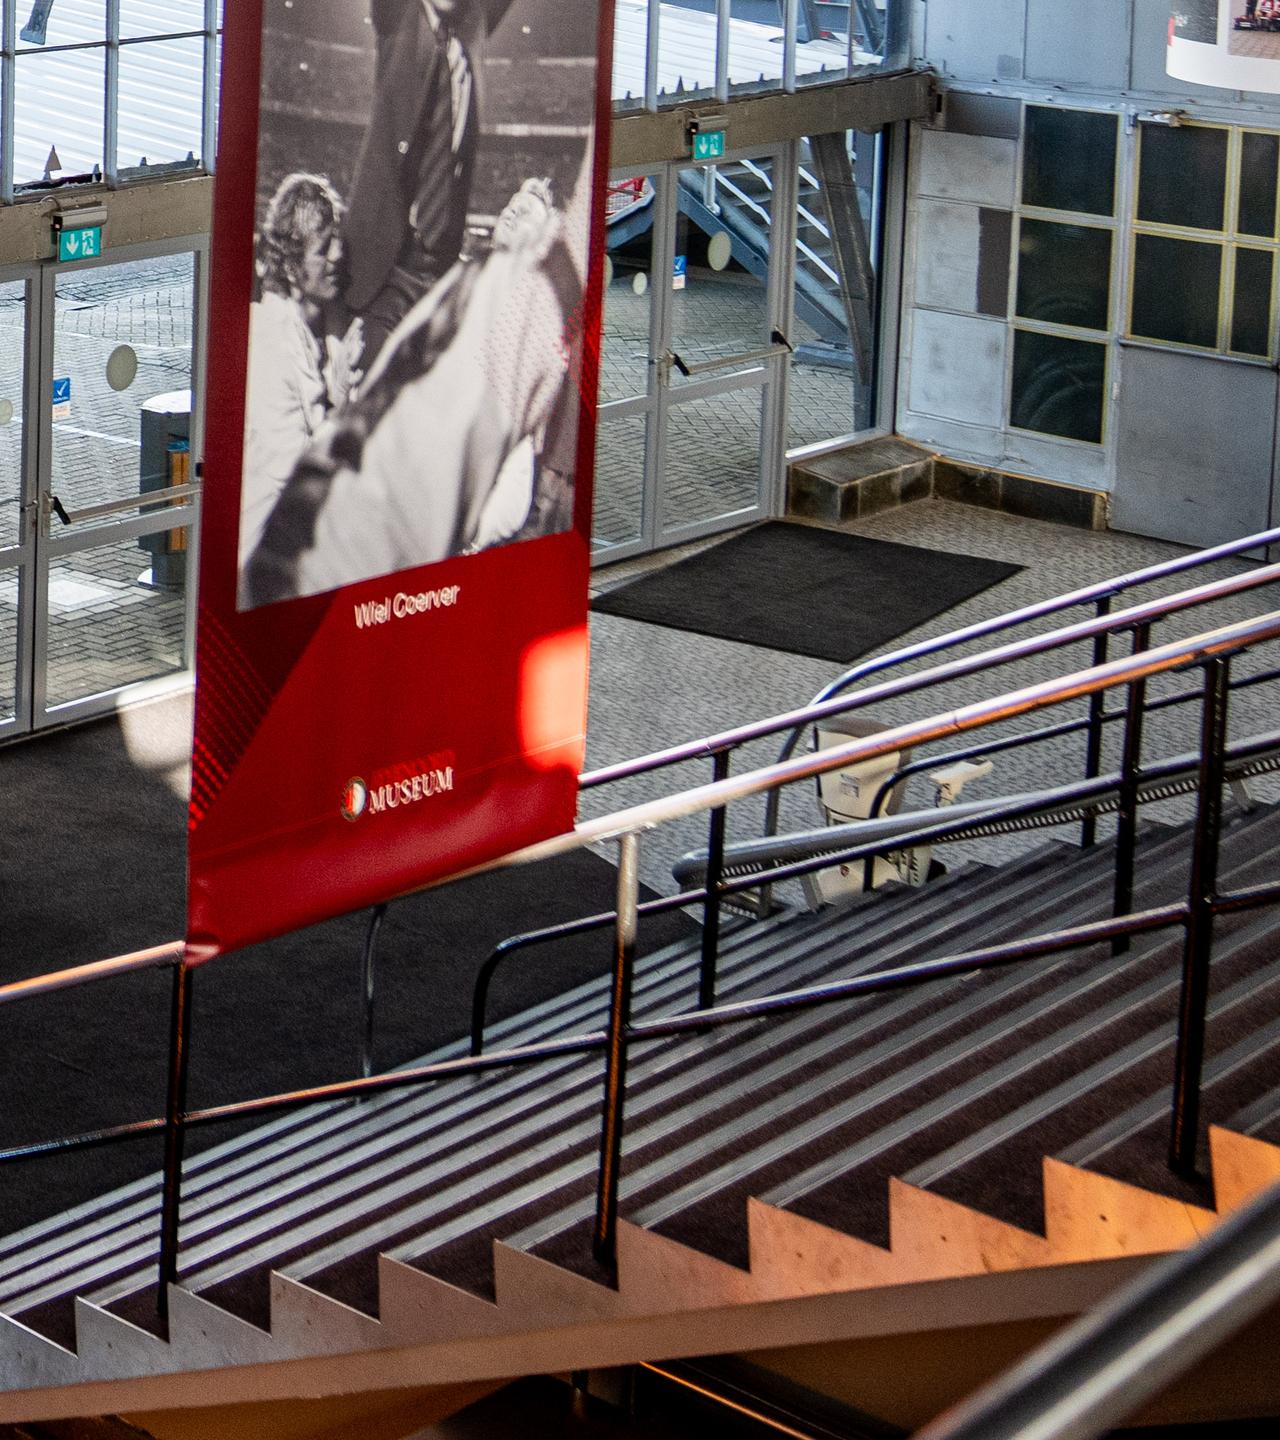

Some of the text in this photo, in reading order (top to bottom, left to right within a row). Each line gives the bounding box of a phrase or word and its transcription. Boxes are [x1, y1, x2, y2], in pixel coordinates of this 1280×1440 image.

[354, 584, 460, 628] Wiel Coerver
[368, 766, 454, 815] MUSEUM
